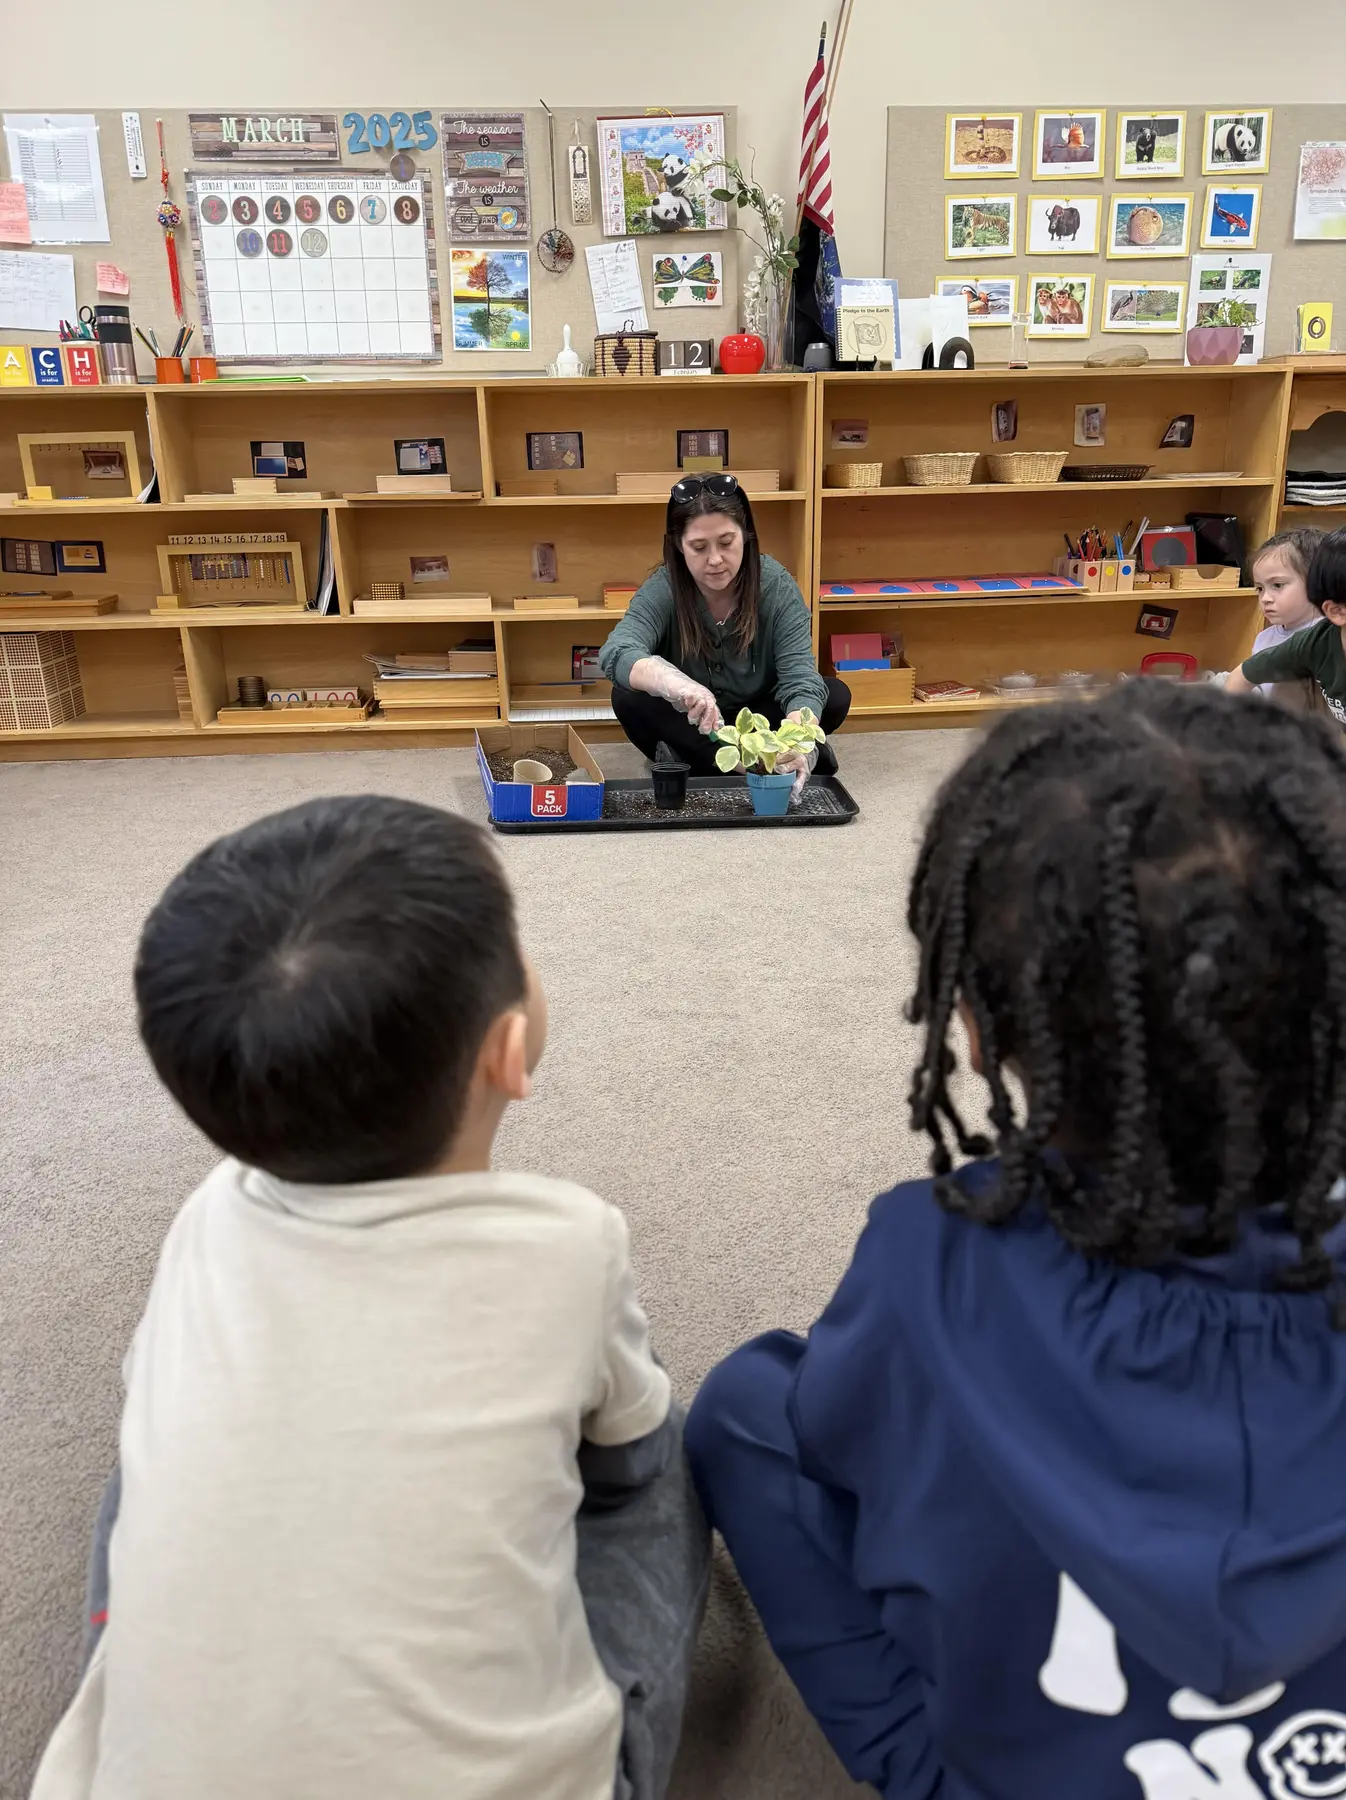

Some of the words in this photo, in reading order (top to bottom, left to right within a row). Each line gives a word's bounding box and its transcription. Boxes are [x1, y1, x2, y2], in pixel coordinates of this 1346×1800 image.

[220, 117, 305, 142] MARCH
[343, 110, 438, 153] 2025
[453, 120, 475, 134] The
[477, 126, 513, 134] season
[202, 182, 223, 190] SUNDAY
[234, 182, 256, 190] MONDAY
[265, 182, 288, 190] TUESDAY
[294, 182, 324, 190] WEDNESDAY
[327, 182, 354, 190] THURSDAY
[363, 182, 382, 190] FRIDAY
[391, 182, 418, 190] SATURDAY
[455, 180, 477, 194] The
[479, 181, 519, 194] weather
[208, 200, 219, 220] 2
[240, 200, 250, 220] 3
[272, 200, 283, 220] 4
[304, 200, 313, 220] 5
[336, 200, 346, 220] 6
[368, 199, 377, 220] 7
[402, 200, 413, 220] 8
[481, 216, 497, 225] AND
[242, 232, 259, 254] 10
[272, 232, 288, 253] 11
[306, 232, 322, 253] 12
[4, 350, 21, 368] A
[38, 350, 56, 368] C
[73, 350, 90, 368] H
[40, 368, 46, 376] is
[47, 368, 58, 376] for
[75, 368, 81, 376] is
[82, 368, 92, 376] for
[171, 537, 180, 545] 11
[184, 536, 194, 544] 12
[198, 536, 206, 544] 13
[210, 536, 220, 544] 14
[224, 536, 232, 544] 15
[250, 535, 258, 543] 17
[262, 535, 272, 543] 18
[276, 534, 285, 542] 19
[545, 790, 556, 805] 5
[537, 805, 562, 813] PACK
